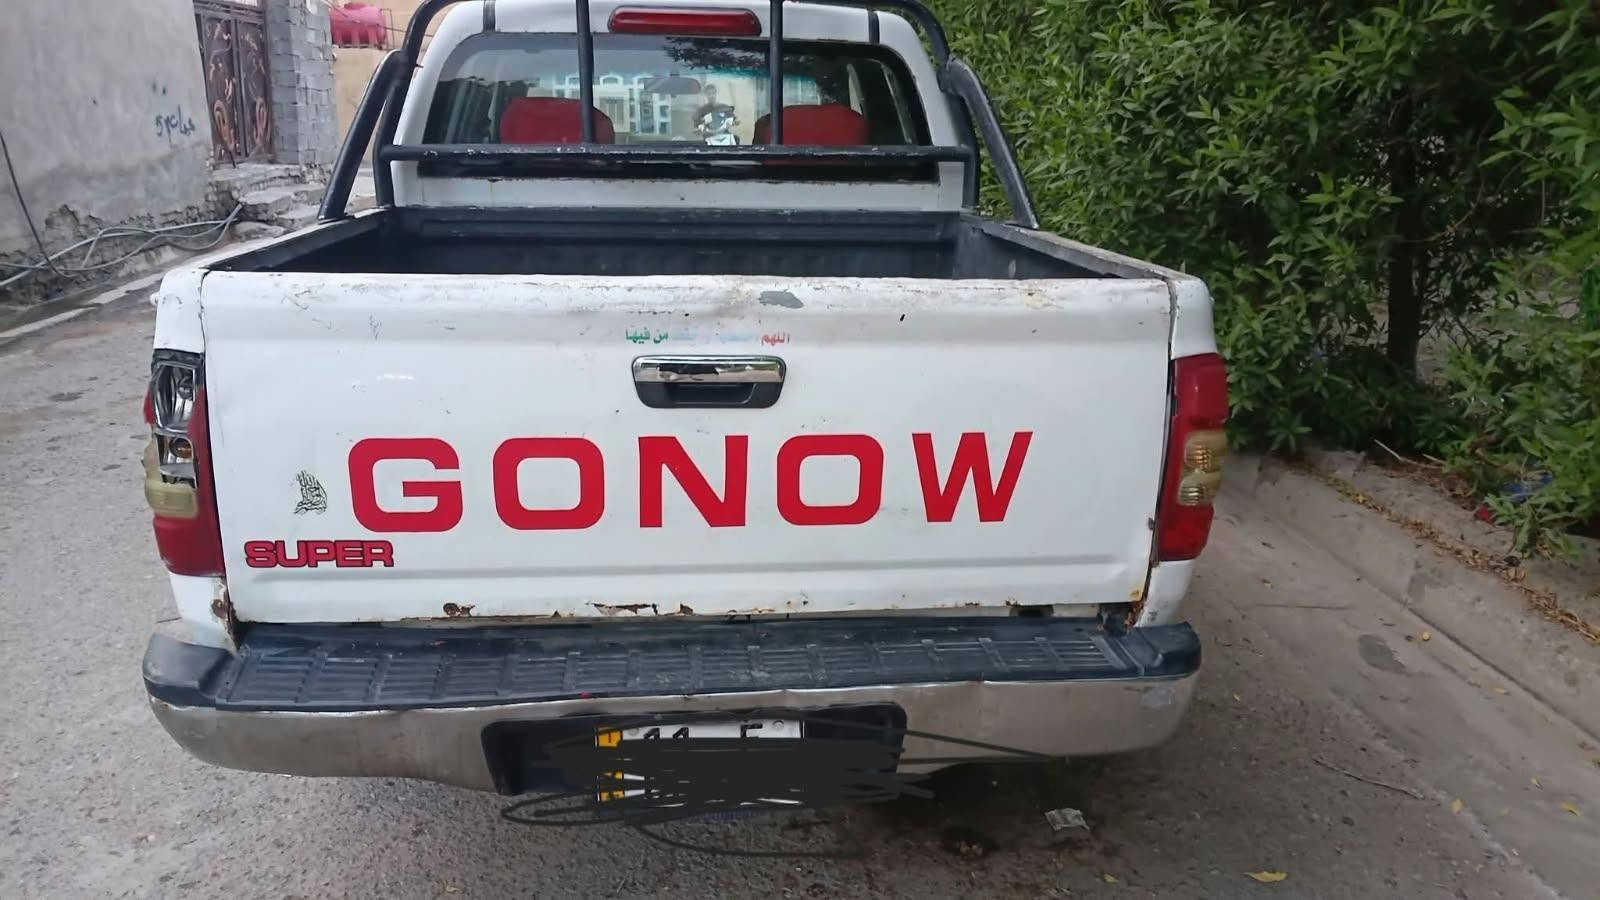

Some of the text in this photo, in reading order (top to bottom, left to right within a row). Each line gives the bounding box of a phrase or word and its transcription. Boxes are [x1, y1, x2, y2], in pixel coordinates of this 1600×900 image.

[760, 330, 791, 346] اللهم
[348, 431, 1033, 532] GONOW
[244, 539, 394, 568] SUPER
